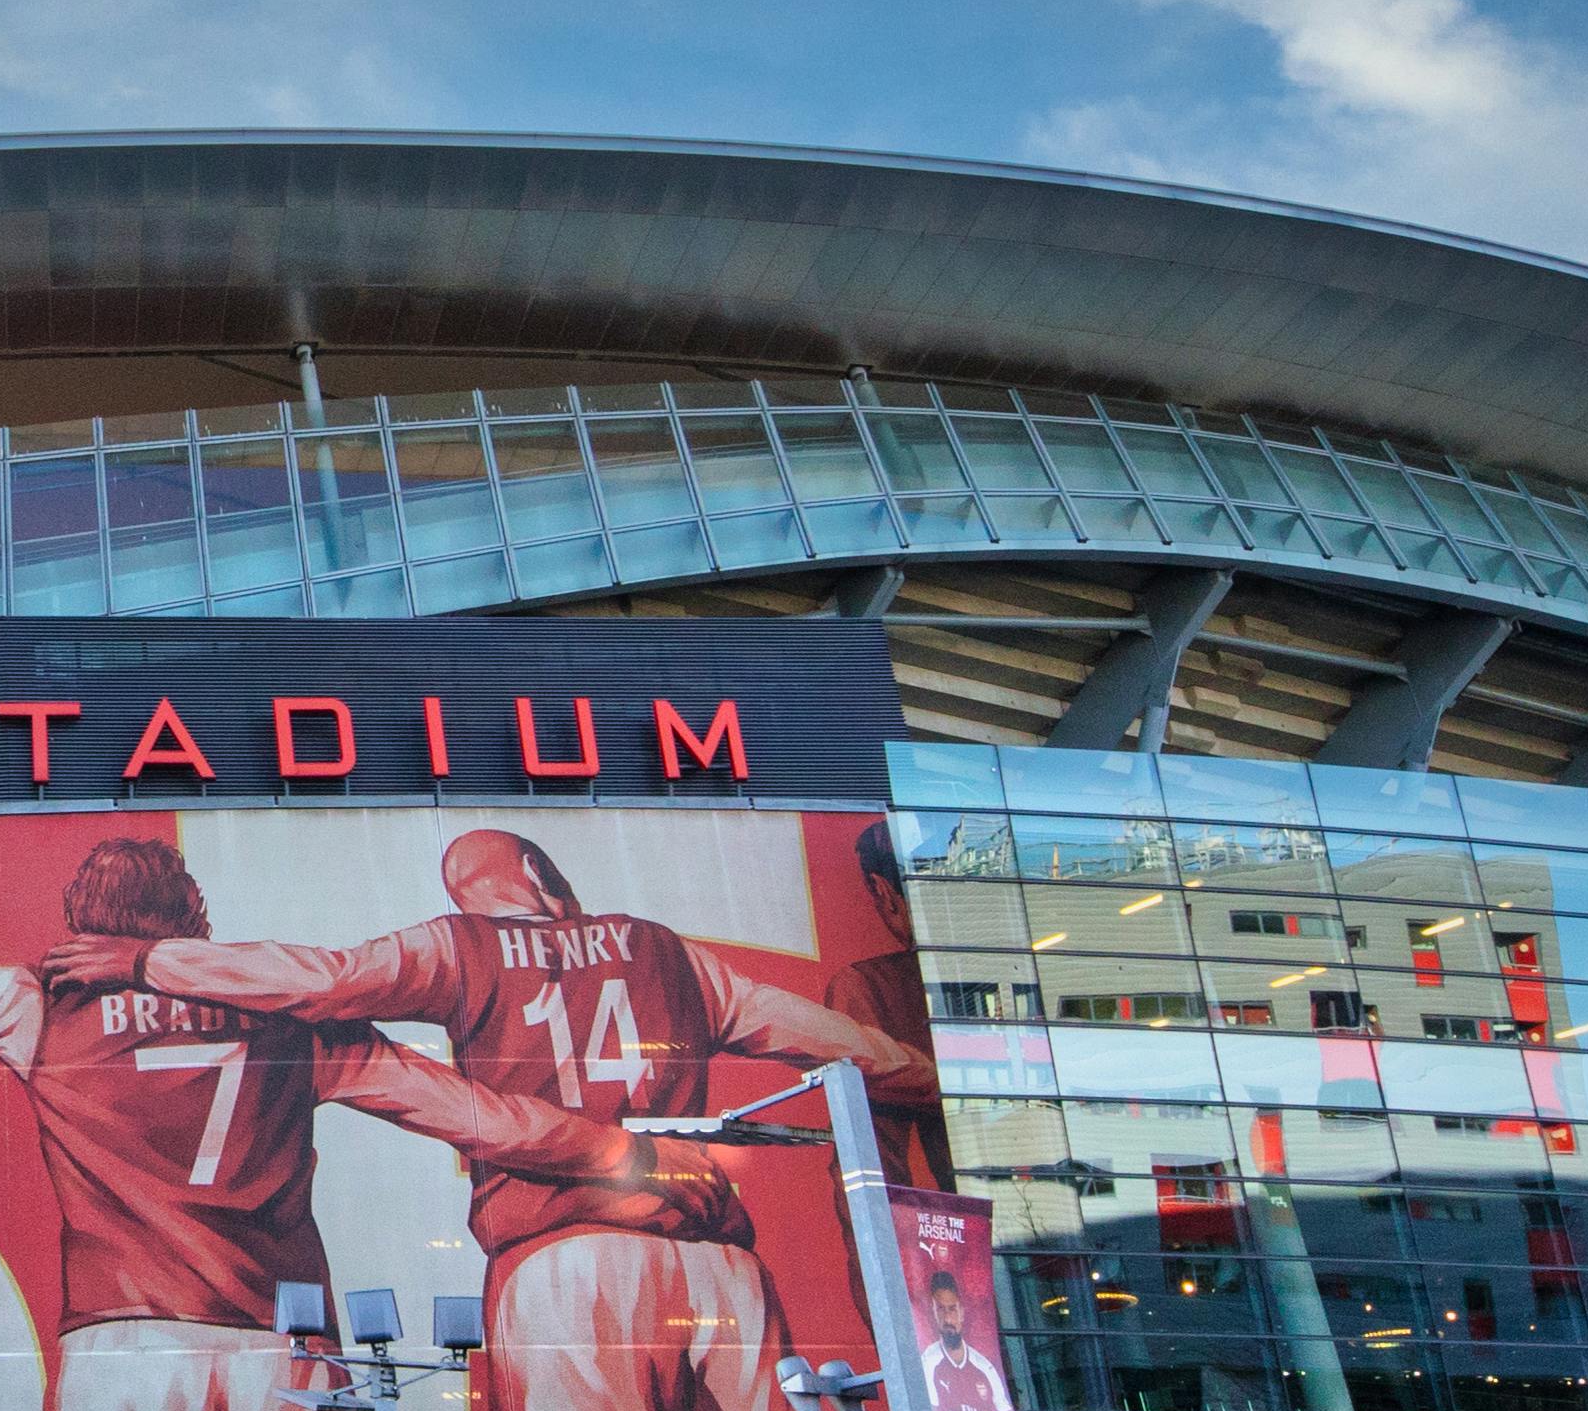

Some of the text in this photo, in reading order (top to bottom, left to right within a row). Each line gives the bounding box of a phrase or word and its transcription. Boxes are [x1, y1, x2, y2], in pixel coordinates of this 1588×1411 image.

[496, 922, 633, 969] HENRY
[523, 978, 655, 1109] 14
[135, 1042, 248, 1185] 7
[917, 1212, 964, 1229] WE ARE THE
[918, 1223, 965, 1243] ARSENAL
